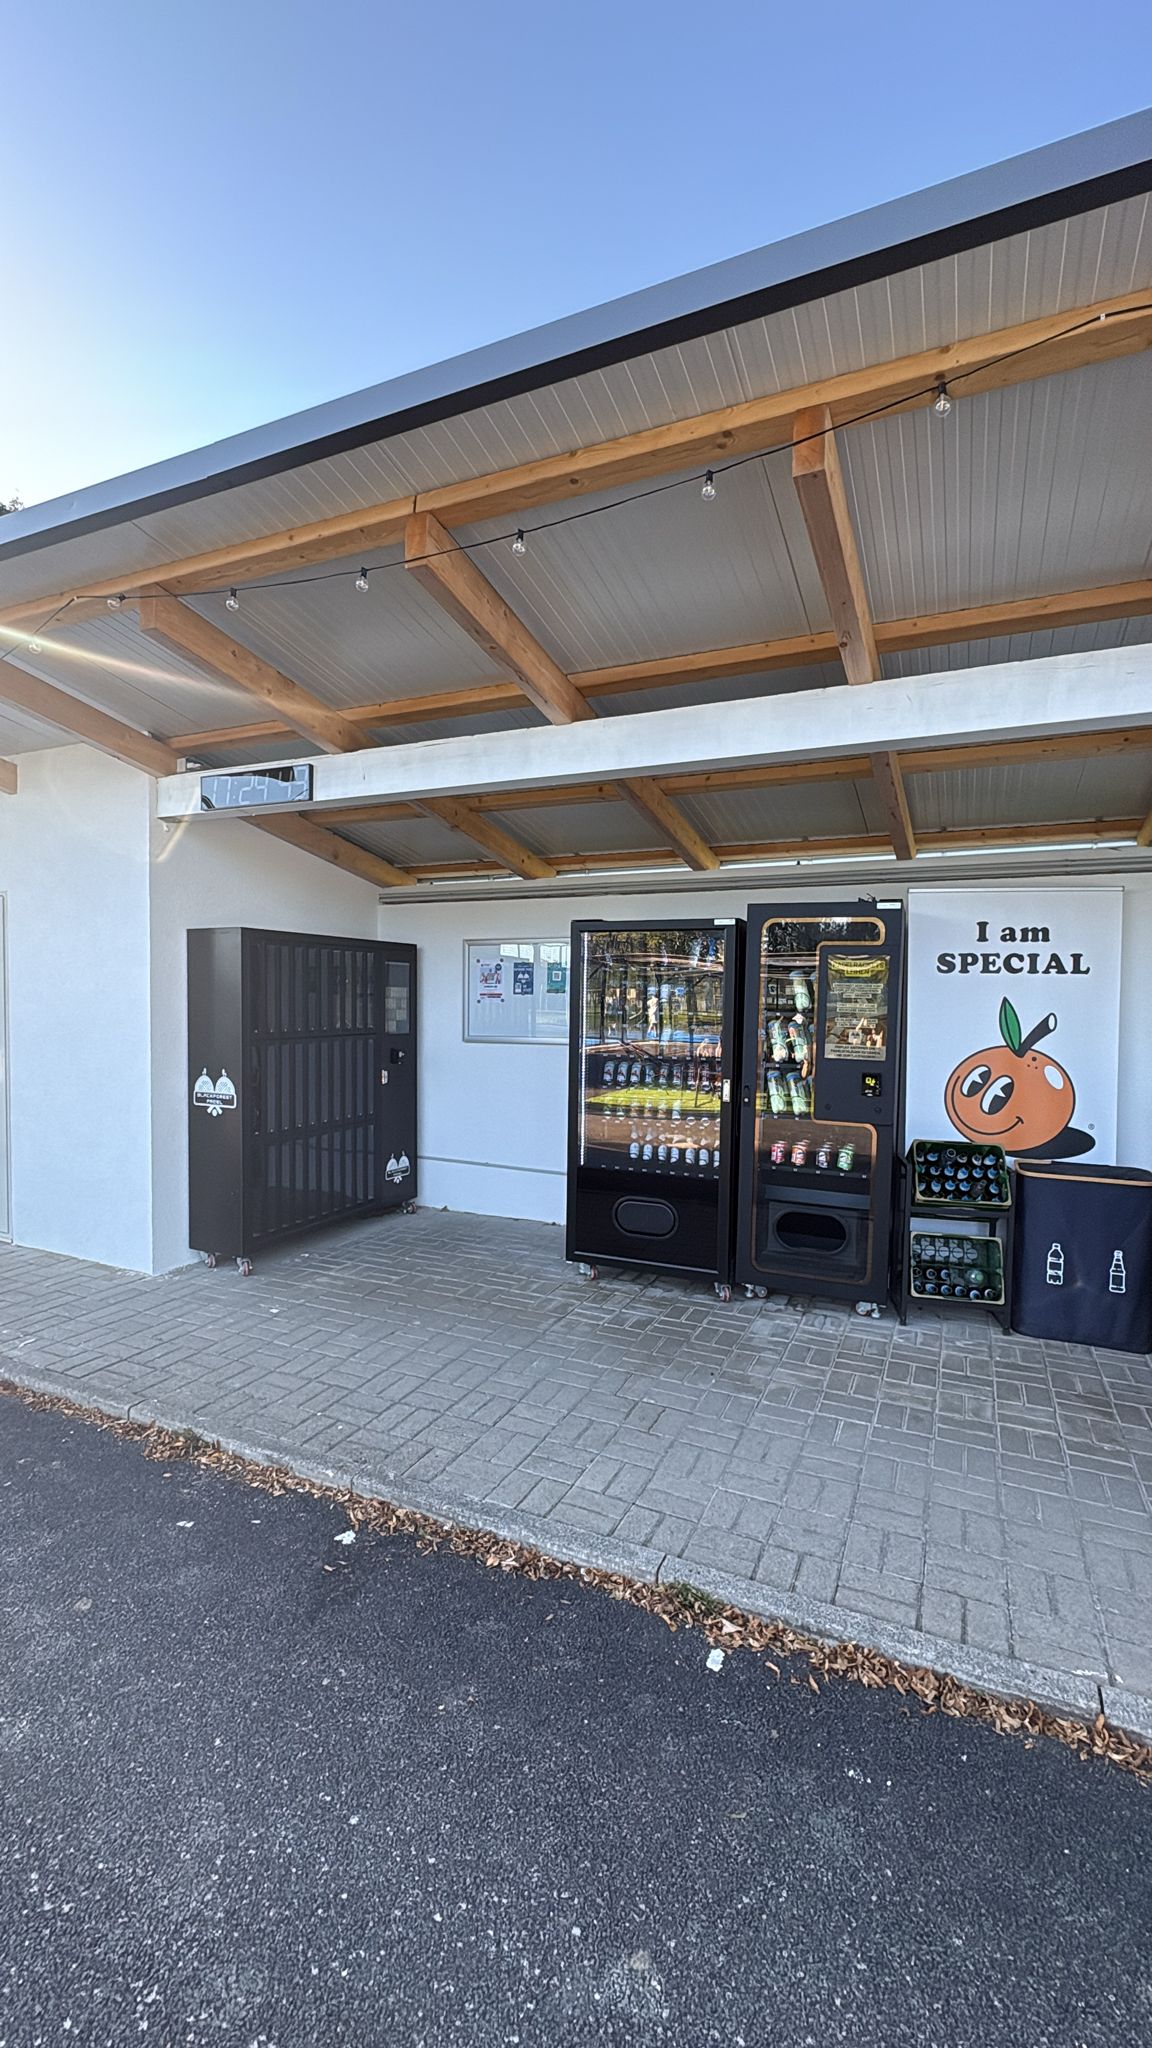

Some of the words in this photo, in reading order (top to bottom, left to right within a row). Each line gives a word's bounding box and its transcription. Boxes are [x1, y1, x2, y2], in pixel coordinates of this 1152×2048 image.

[213, 772, 269, 805] 17:24
[976, 921, 990, 943] I
[1000, 927, 1051, 943] am
[936, 952, 1091, 975] SPECIAL
